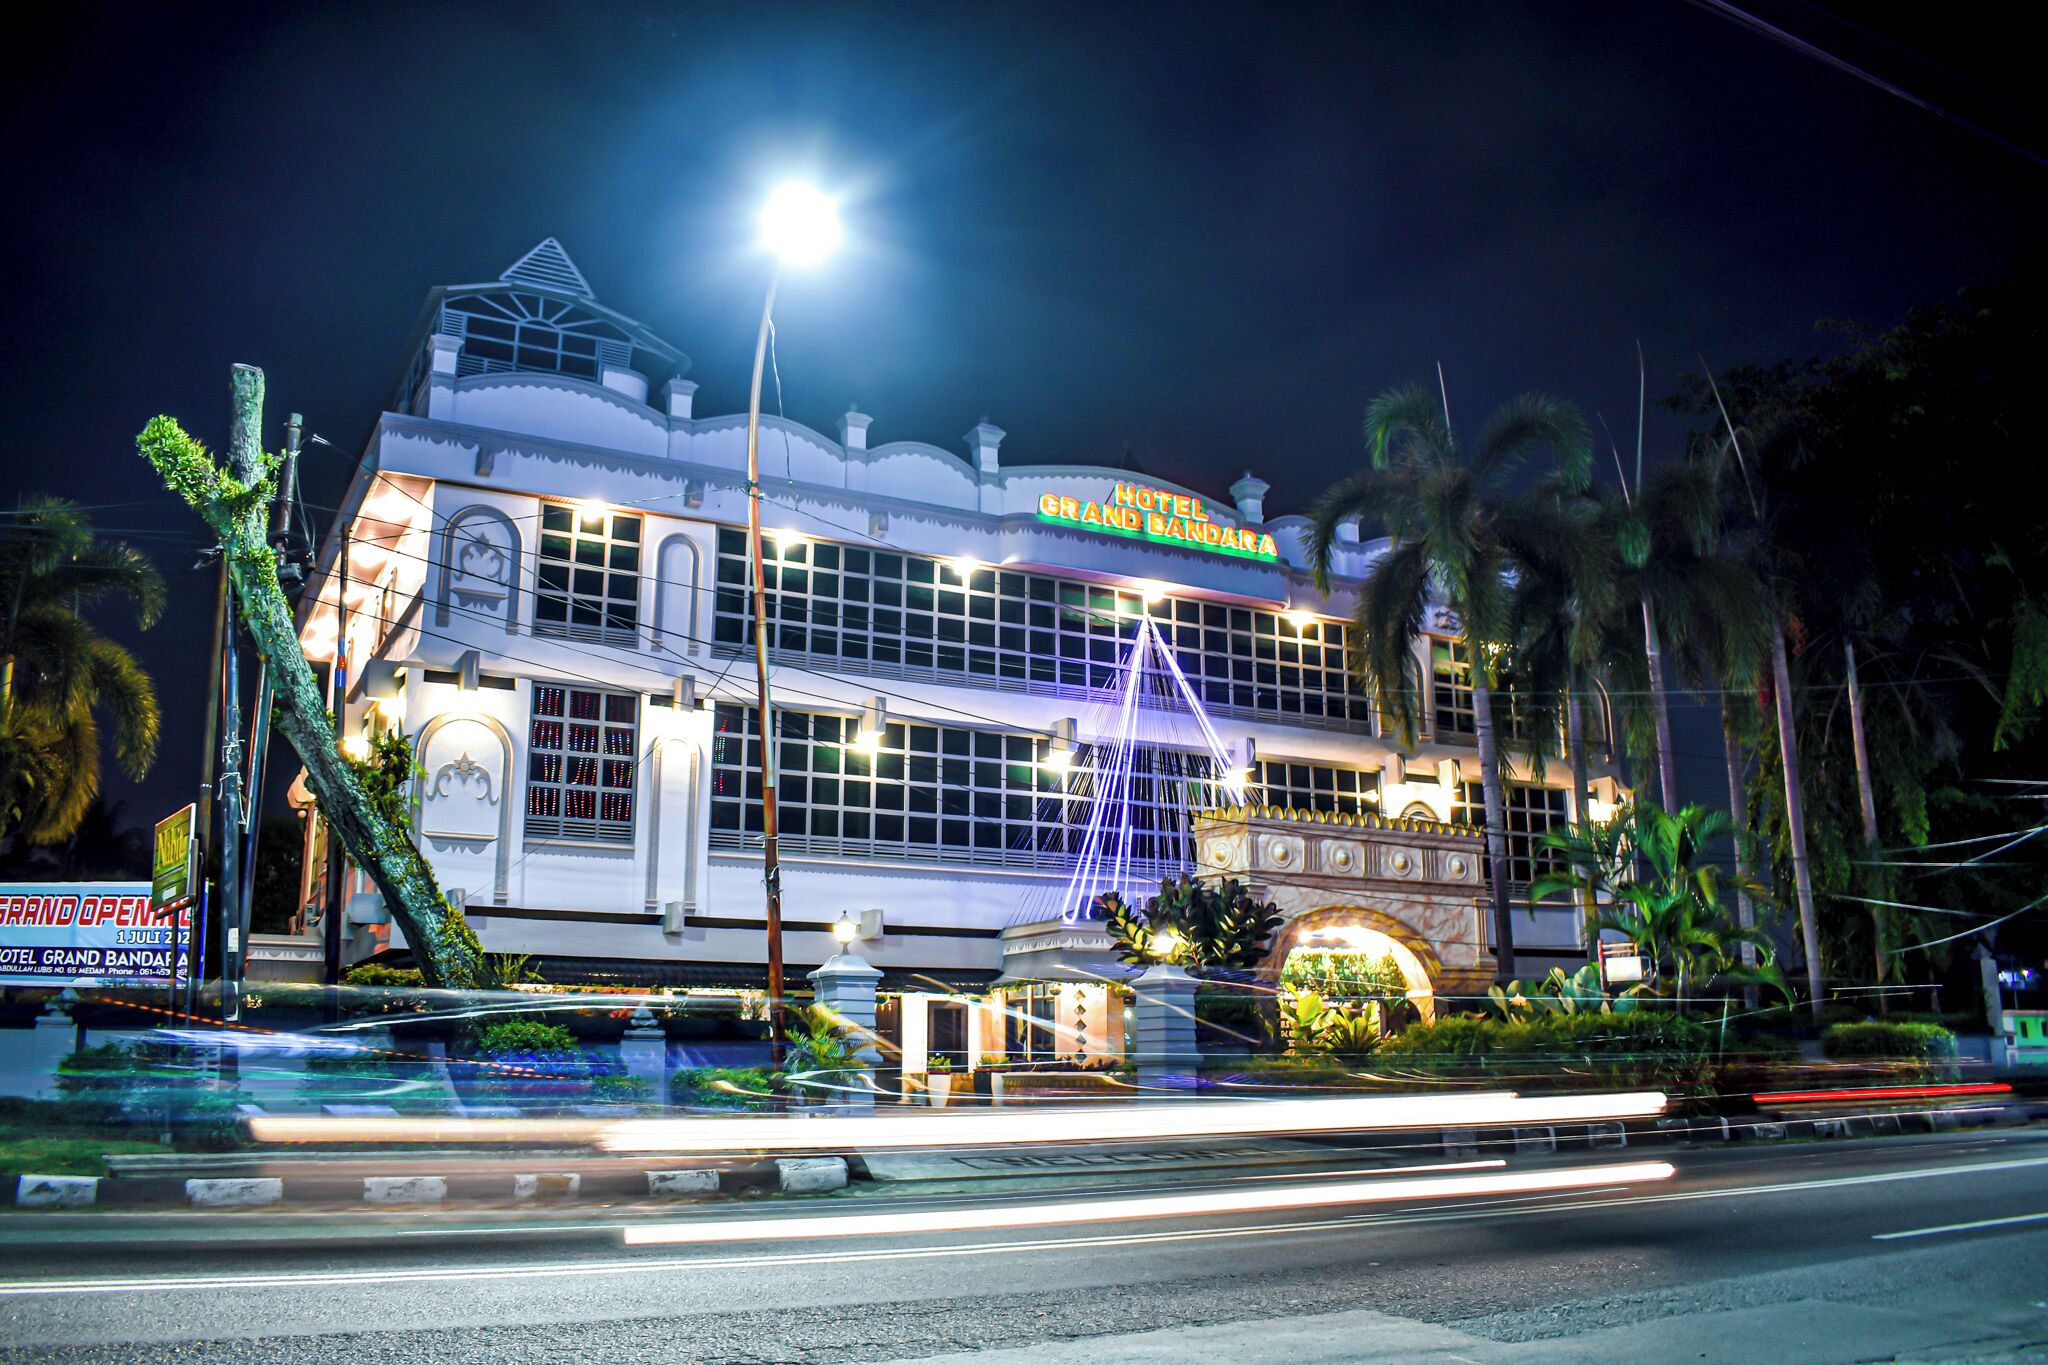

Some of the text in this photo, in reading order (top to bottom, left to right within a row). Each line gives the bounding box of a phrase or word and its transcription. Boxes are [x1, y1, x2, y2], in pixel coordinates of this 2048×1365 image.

[1115, 483, 1209, 521] HOTEL
[1039, 493, 1278, 557] GRAND BANDARA
[117, 930, 125, 944] 1
[128, 930, 160, 944] JULI
[0, 948, 37, 965] OTEL
[43, 949, 100, 966] GRAND
[34, 965, 53, 973] LUBIS
[67, 966, 77, 974] 65
[79, 967, 105, 975] MEDAN
[108, 967, 134, 975] Phone
